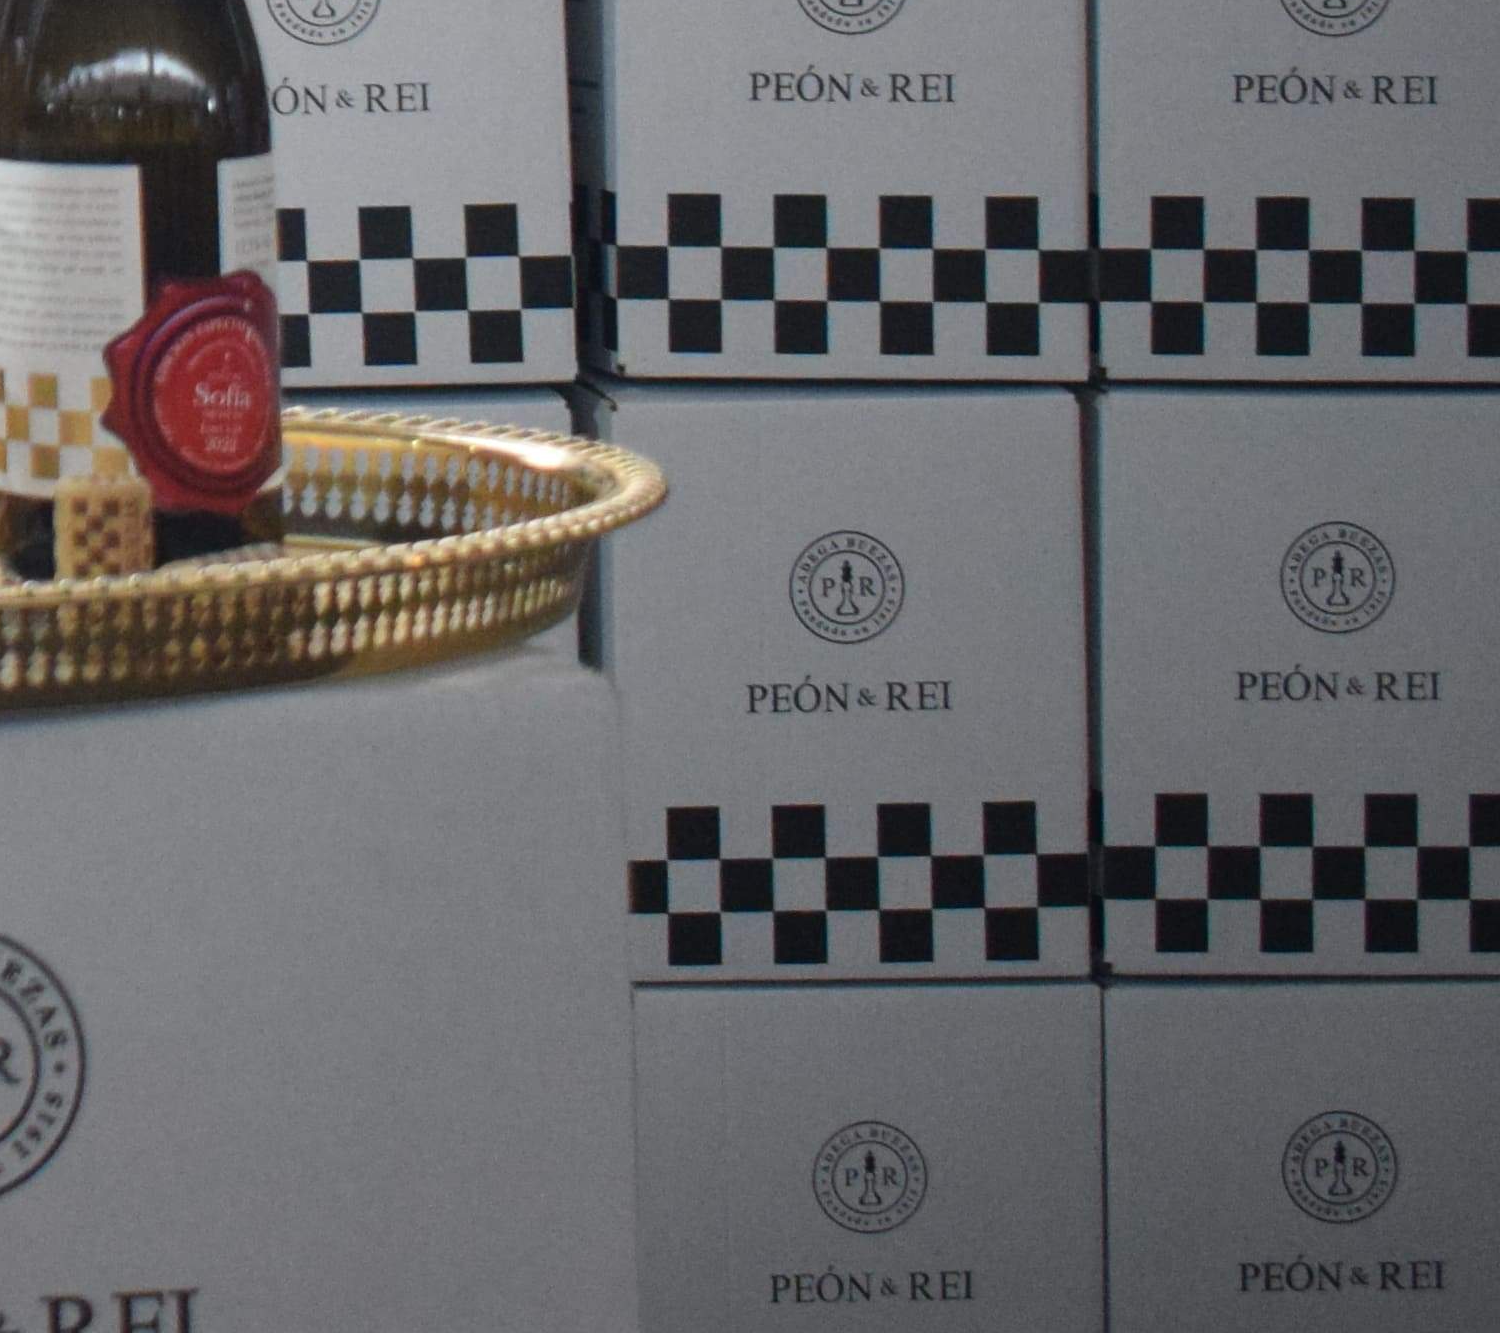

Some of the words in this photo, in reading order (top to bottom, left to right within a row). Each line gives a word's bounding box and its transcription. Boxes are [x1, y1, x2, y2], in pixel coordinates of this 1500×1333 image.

[271, 76, 327, 116] ÓN
[335, 89, 354, 109] &
[363, 82, 431, 114] REI
[750, 64, 853, 103] PEÓN
[860, 80, 879, 97] &
[889, 73, 955, 103] REI
[1233, 66, 1335, 105] PEÓN
[1343, 81, 1361, 99] &
[1371, 75, 1438, 105] REI
[821, 577, 836, 597] P
[859, 576, 877, 596] R
[1312, 567, 1326, 587] P
[1349, 567, 1367, 587] R
[747, 674, 849, 714] PEÓN
[857, 688, 876, 707] &
[886, 680, 951, 712] REI
[1237, 664, 1339, 702] PEÓN
[1346, 678, 1364, 696] &
[1375, 671, 1441, 702] REI
[844, 1167, 859, 1187] P
[882, 1167, 899, 1186] R
[1314, 1158, 1328, 1177] P
[1352, 1157, 1369, 1177] R
[770, 1265, 871, 1304] PEÓN
[880, 1278, 898, 1296] &
[909, 1270, 974, 1302] REI
[1239, 1254, 1343, 1292] PEÓN
[1349, 1267, 1370, 1286] &
[1378, 1260, 1445, 1291] REI
